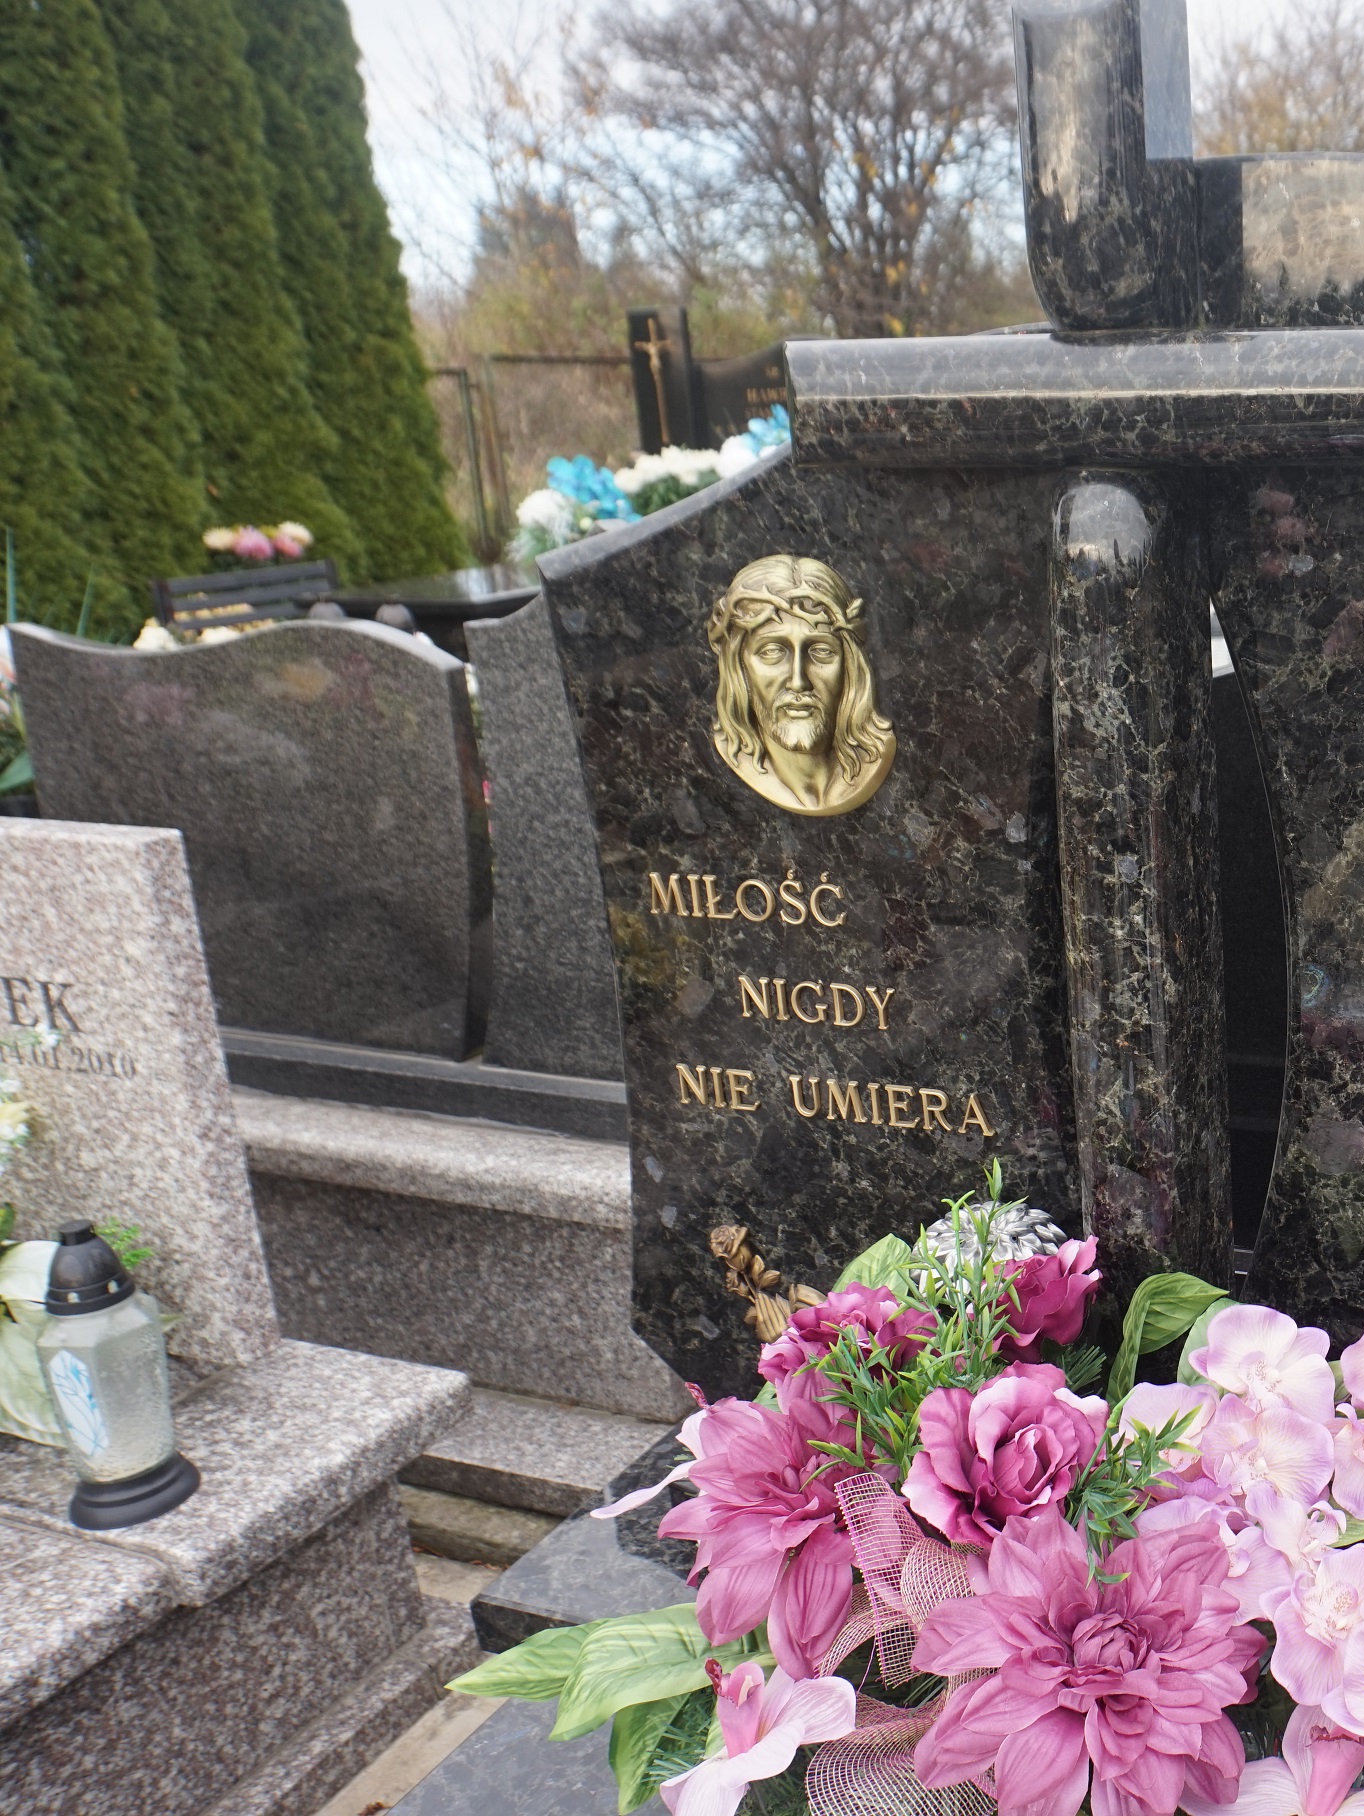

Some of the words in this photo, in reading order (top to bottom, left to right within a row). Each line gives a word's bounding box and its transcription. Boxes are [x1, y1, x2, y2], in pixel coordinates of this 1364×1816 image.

[648, 869, 848, 928] MIŁOŚĆ
[737, 974, 896, 1030] NIGDY
[675, 1062, 762, 1112] NIE
[788, 1074, 996, 1138] UMIERA
